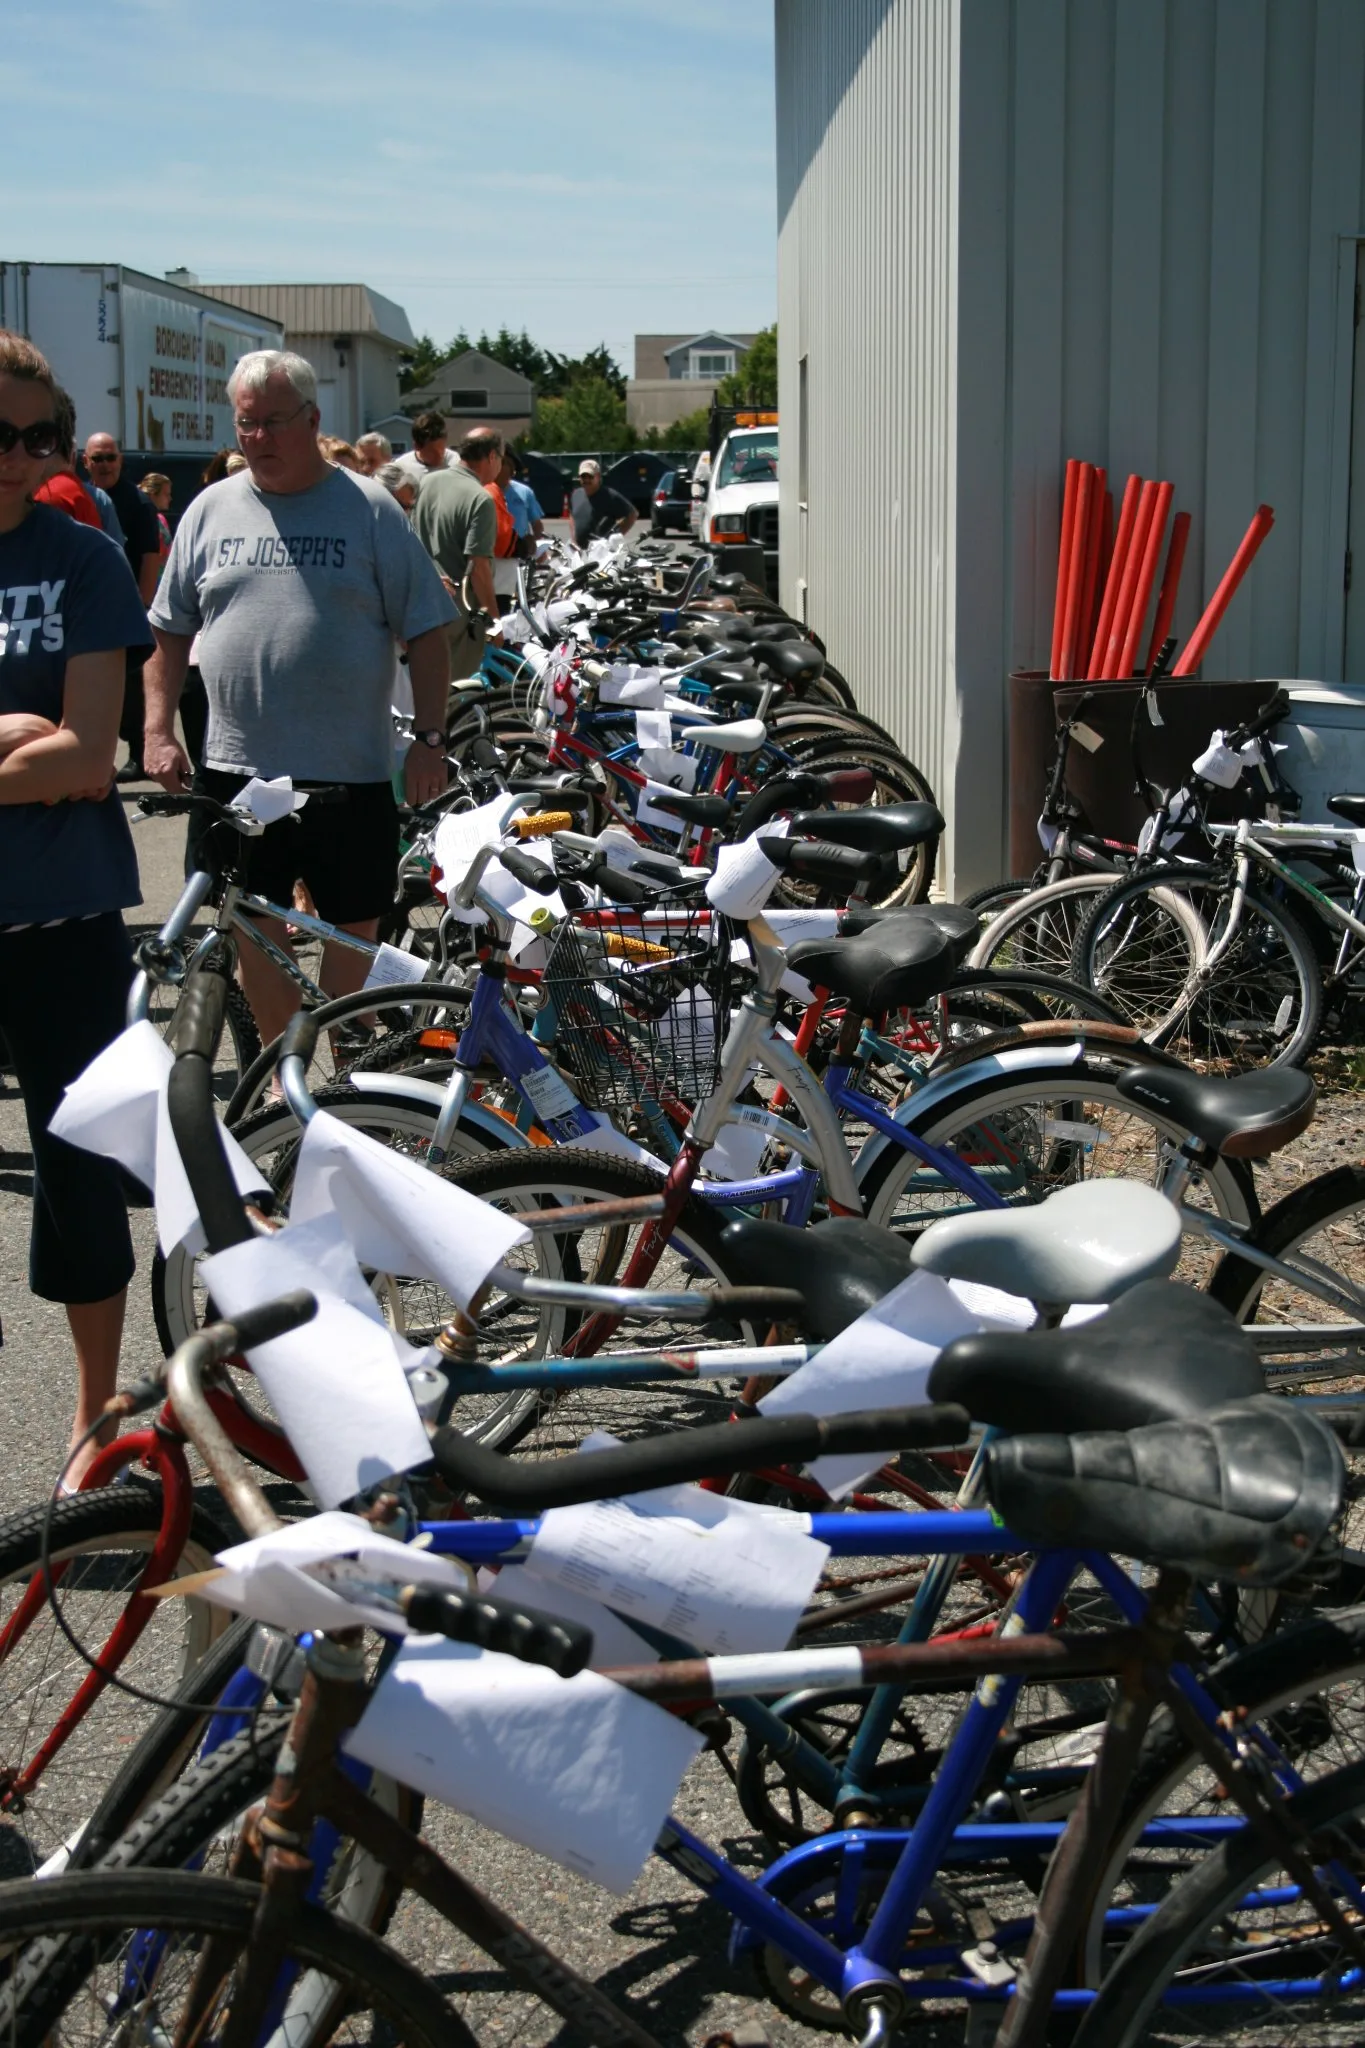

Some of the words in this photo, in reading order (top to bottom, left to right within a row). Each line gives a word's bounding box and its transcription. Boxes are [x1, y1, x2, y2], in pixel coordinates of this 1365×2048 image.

[155, 325, 192, 362] BOROUGH
[149, 365, 193, 401] EMERGENCY
[172, 411, 186, 440] PET
[218, 537, 245, 568] ST.
[247, 535, 346, 569] JOSEPH'S
[250, 931, 330, 1003] SCHW
[729, 1185, 776, 1198] ALUMINUM
